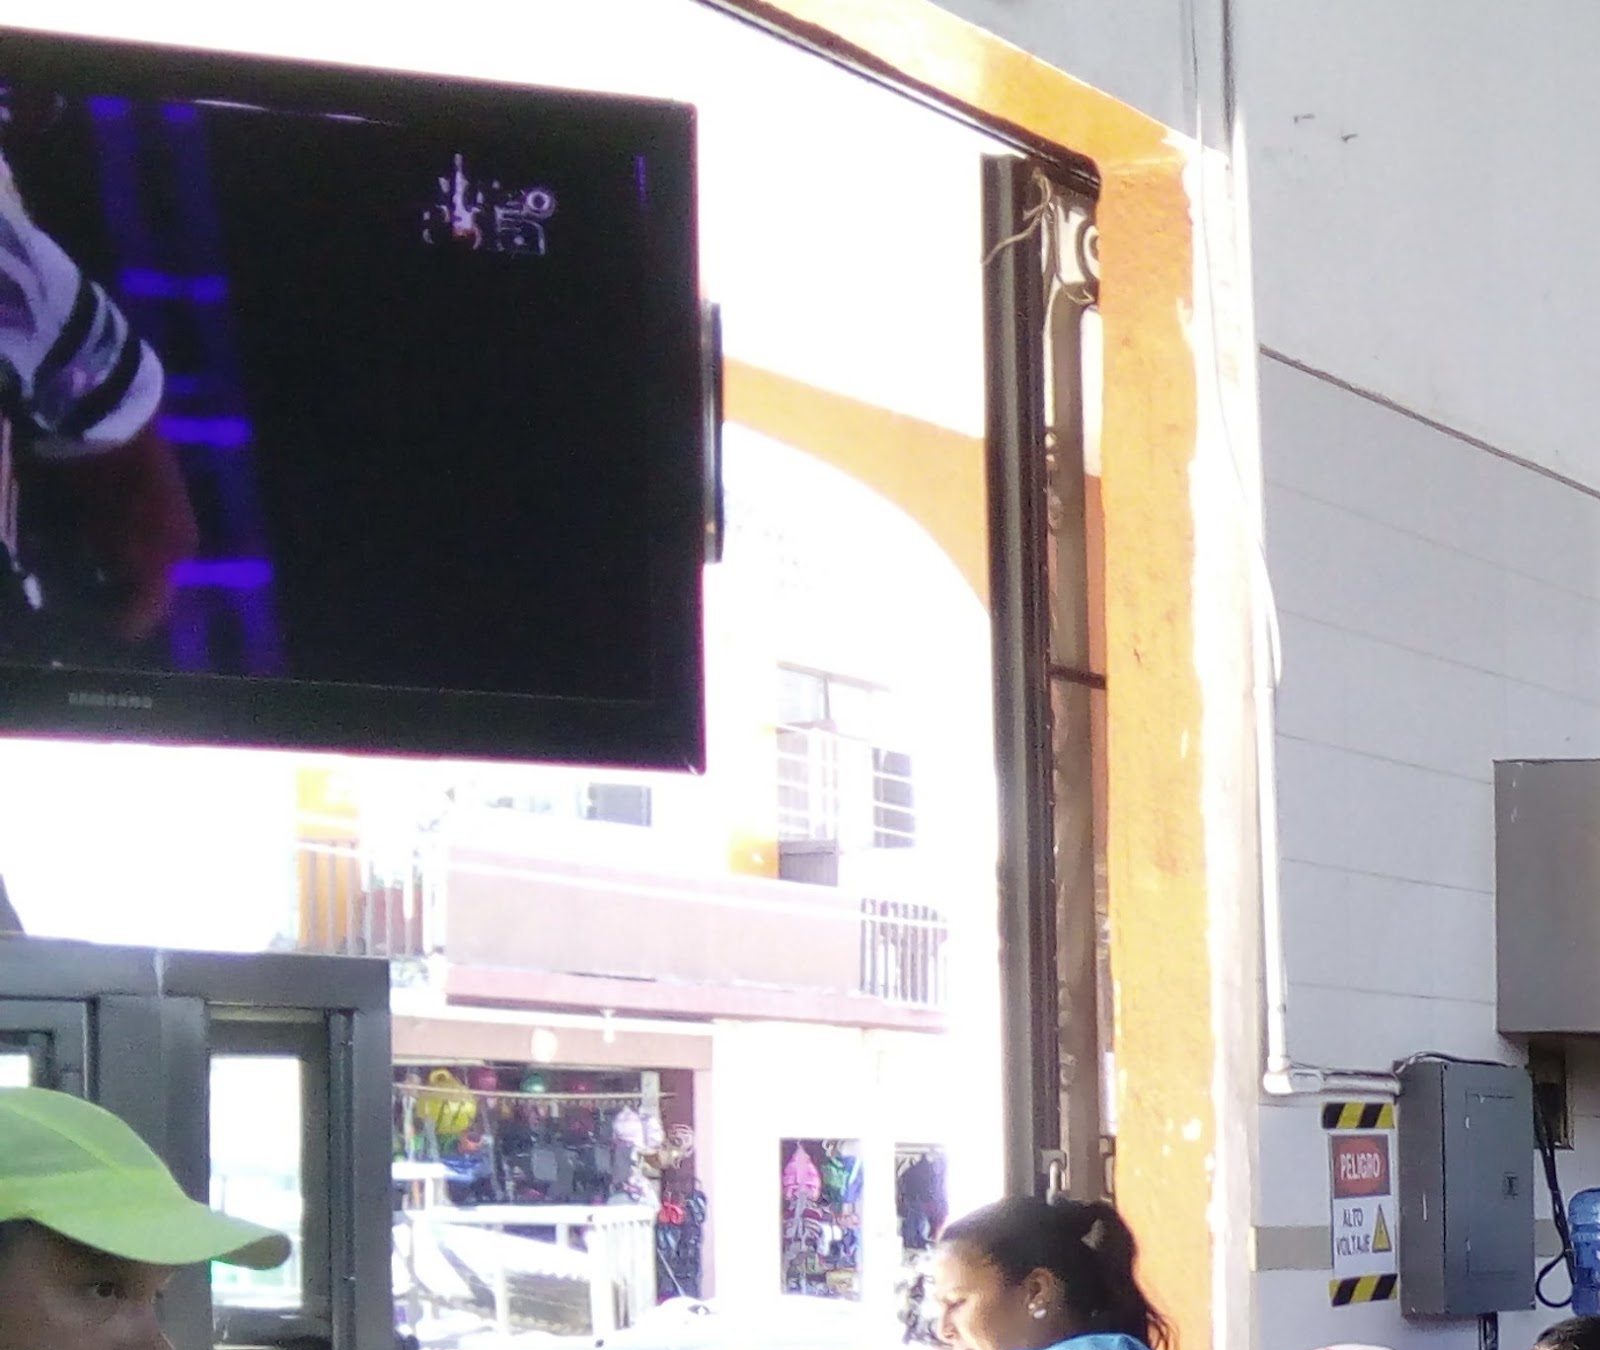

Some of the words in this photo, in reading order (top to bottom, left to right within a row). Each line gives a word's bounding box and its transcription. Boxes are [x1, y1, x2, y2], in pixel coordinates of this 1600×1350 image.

[1340, 1152, 1381, 1181] PELIGRO
[1342, 1208, 1364, 1228] ALTO
[1336, 1234, 1371, 1257] VOLTAJE
